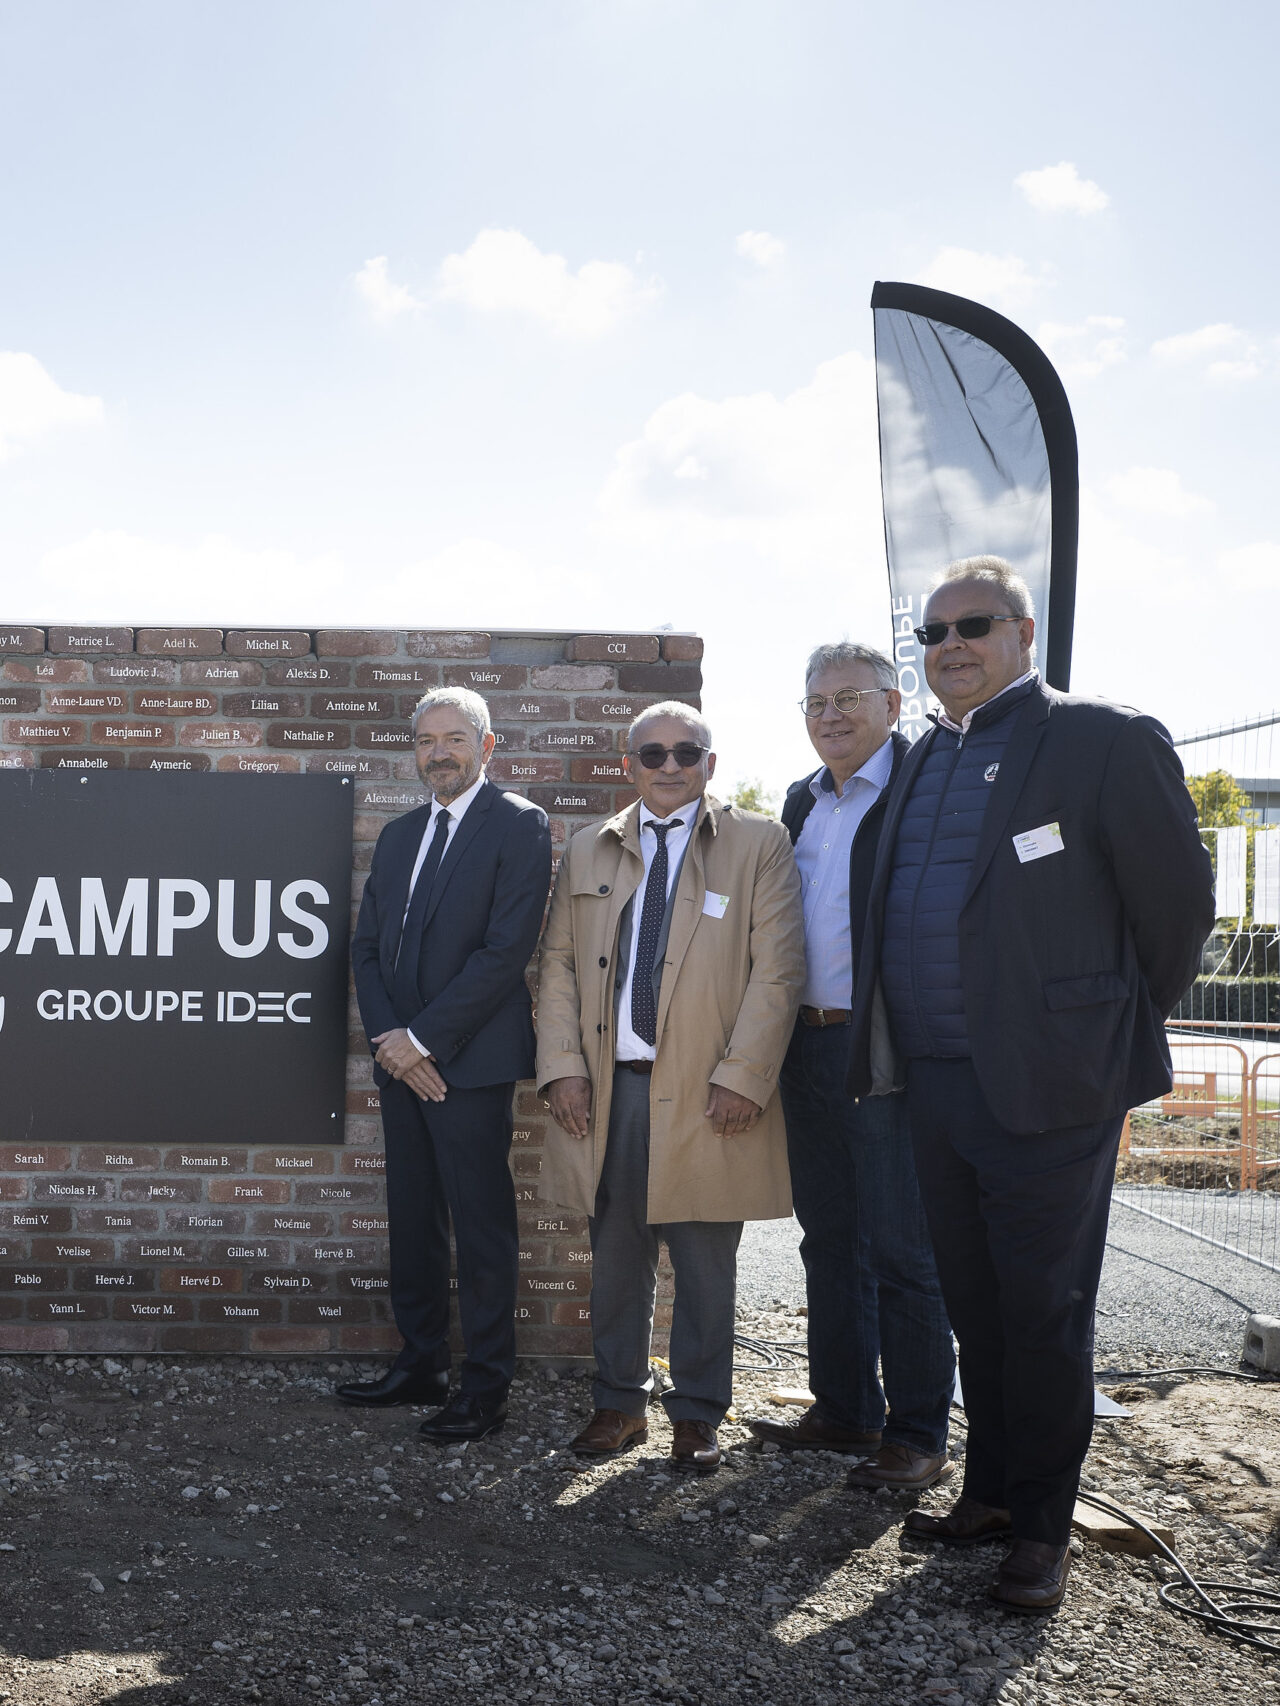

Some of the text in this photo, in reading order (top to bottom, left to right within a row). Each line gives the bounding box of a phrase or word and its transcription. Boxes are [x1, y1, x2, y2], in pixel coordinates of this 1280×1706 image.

[9, 635, 23, 647] M.
[68, 635, 115, 648] Patrice L.
[162, 638, 199, 648] Adel K.
[246, 639, 292, 650] Michel R.
[607, 642, 626, 654] CCI
[36, 664, 55, 676] Léa
[109, 666, 160, 678] Ludovic J.
[204, 667, 239, 678] Adrien
[285, 667, 331, 679] Alexis D.
[372, 670, 424, 682] Thomas L.
[469, 671, 502, 685] Valéry
[51, 696, 124, 707] Anne-Laure VD.
[140, 697, 212, 709] Anne-Laure BD.
[251, 699, 279, 711] Lilian
[325, 701, 381, 712] Antoine M.
[519, 703, 540, 713] Aita
[601, 704, 632, 715] Cécile
[19, 726, 71, 737] Mathieu V.
[105, 726, 162, 740] Benjamin P.
[200, 729, 243, 741] Julien B.
[283, 730, 335, 742] Nathalie P.
[370, 731, 410, 743] Ludovic
[547, 734, 597, 745] Lionel PB.
[13, 757, 25, 768] C.
[57, 757, 109, 769] Annabelle
[149, 759, 192, 772] Aymeric
[238, 759, 280, 773] Grégory
[325, 761, 372, 772] Céline M.
[511, 764, 537, 775] Boris
[591, 765, 621, 776] Julien
[363, 792, 427, 805] Alexandre S.
[553, 795, 587, 806] Amina
[36, 989, 204, 1022] GROUPE
[217, 991, 312, 1024] IDEC
[14, 1153, 45, 1164] Sarah
[105, 1154, 134, 1165] Ridha
[180, 1155, 231, 1166] Romain B.
[275, 1157, 313, 1168] Mickael
[354, 1158, 387, 1168] Frédér
[48, 1184, 98, 1195] Nicolas H.
[147, 1185, 176, 1198] Jacky
[234, 1186, 264, 1197] Frank
[320, 1188, 352, 1198] Nicole
[13, 1214, 50, 1225] Rémi V.
[104, 1215, 132, 1226] Tania
[188, 1216, 223, 1227] Florian
[274, 1218, 311, 1230] Noémie
[537, 1220, 569, 1231] Eric L.
[56, 1246, 91, 1257] Yvelise
[140, 1245, 186, 1257] Lionel M.
[227, 1247, 270, 1257] Gilles M.
[314, 1248, 356, 1260] Hervé B.
[14, 1274, 42, 1284] Pablo
[95, 1274, 135, 1285] Hervé J.
[180, 1275, 223, 1286] Hervé D.
[263, 1276, 313, 1289] Sylvain D.
[350, 1277, 389, 1290] Virginie
[527, 1279, 578, 1291] Vincent G.
[49, 1303, 86, 1314] Yann L.
[131, 1304, 176, 1315] Victor M.
[223, 1306, 260, 1316] Yohann
[318, 1306, 342, 1317] Wael
